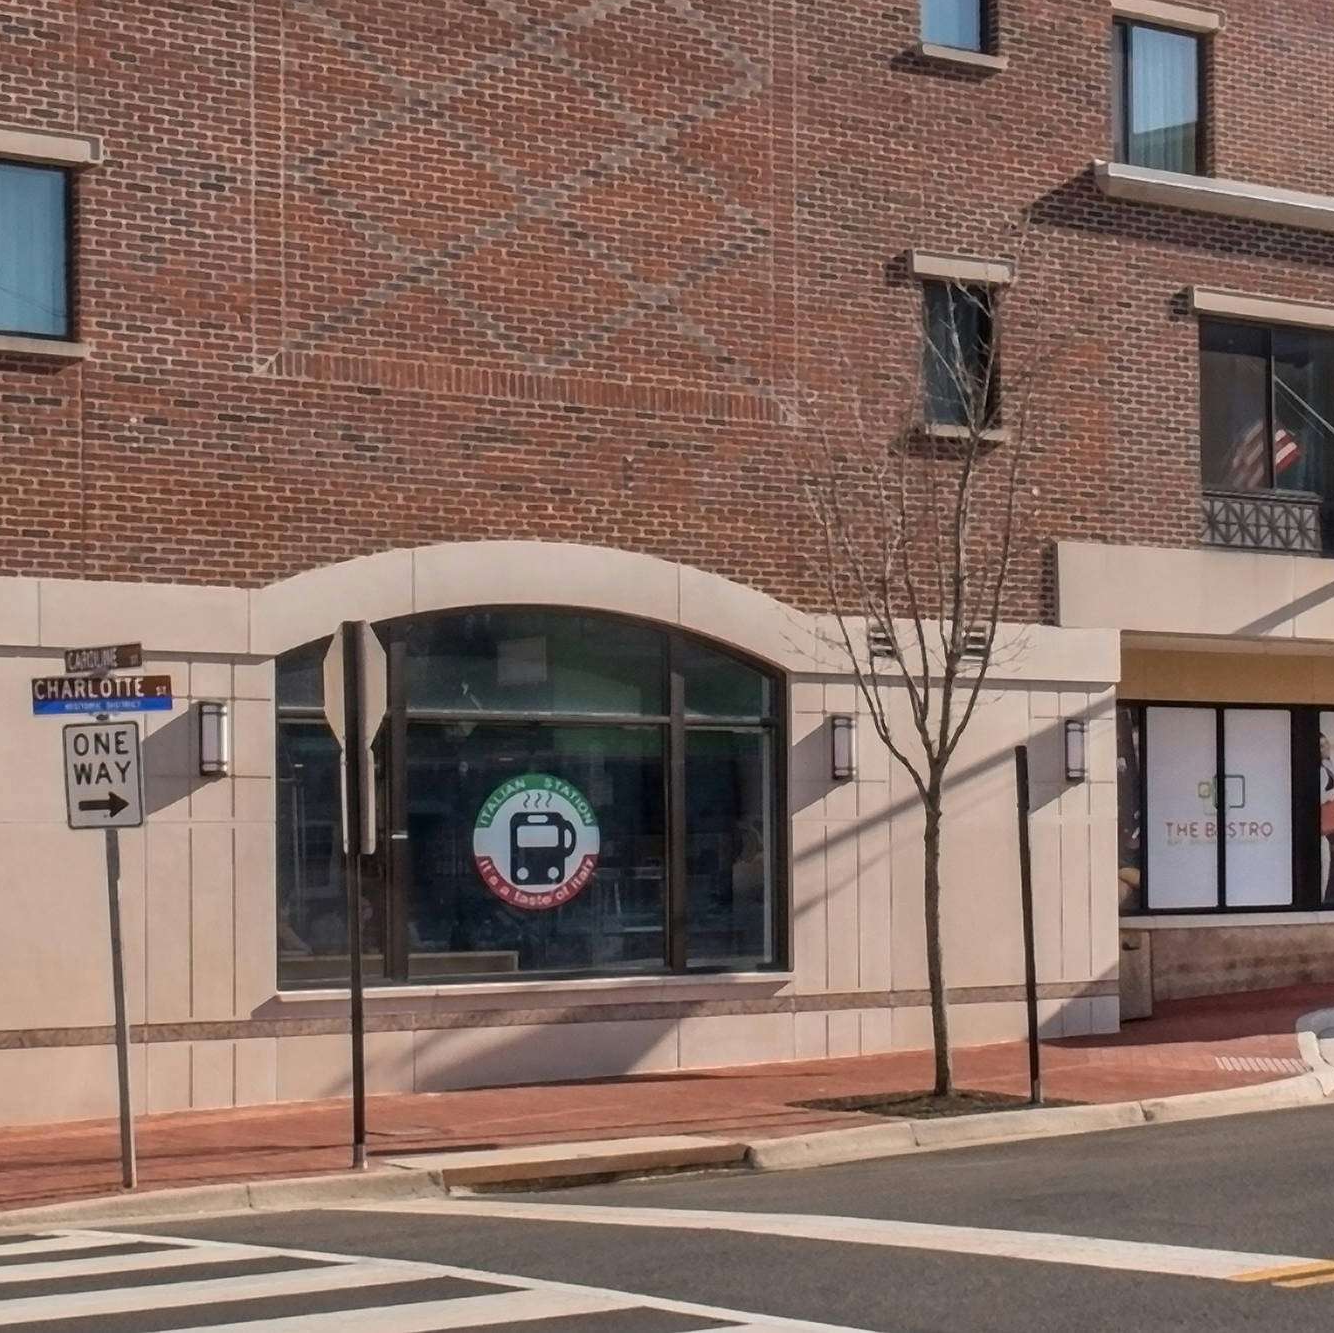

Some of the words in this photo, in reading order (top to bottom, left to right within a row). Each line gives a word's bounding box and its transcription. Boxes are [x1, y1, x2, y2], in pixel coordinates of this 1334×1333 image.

[68, 647, 118, 670] CAROLINE
[34, 677, 145, 699] CHARLOTTE
[156, 686, 167, 696] ST
[73, 730, 131, 756] ONE
[73, 761, 131, 785] WAY
[480, 778, 526, 824] ITALIAN
[544, 777, 594, 824] STATION
[1165, 822, 1198, 838] THE
[1205, 821, 1273, 838] BSTRO
[514, 891, 552, 906] taste
[555, 886, 569, 901] of
